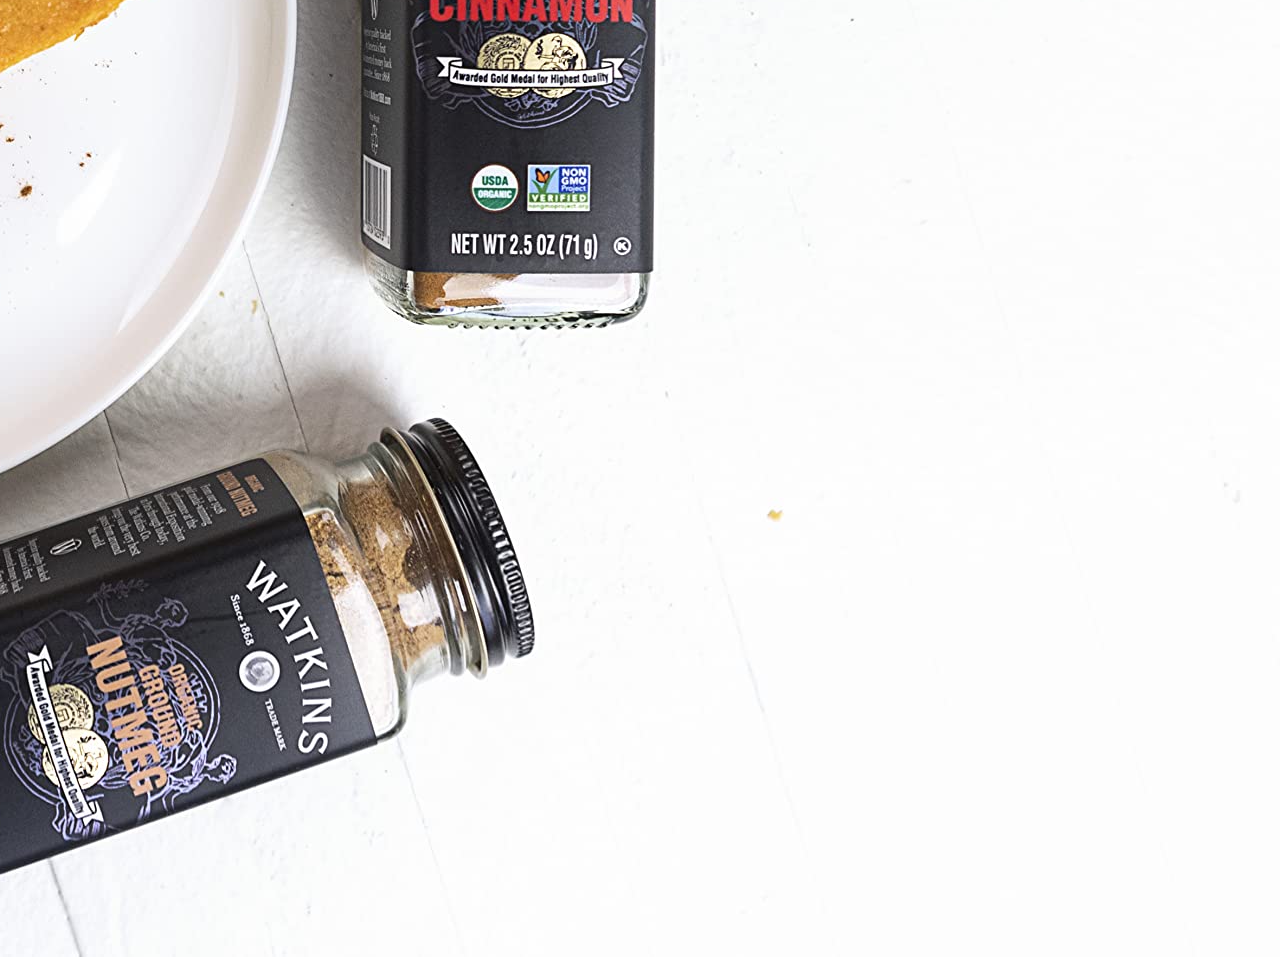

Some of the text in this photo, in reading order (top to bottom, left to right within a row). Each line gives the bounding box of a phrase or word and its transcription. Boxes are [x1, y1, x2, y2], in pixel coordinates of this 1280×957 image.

[452, 70, 609, 86] Awarded Gold Medal for Highest Quality
[481, 175, 508, 186] USDA
[561, 168, 587, 177] NON
[561, 176, 587, 185] GMO
[477, 189, 512, 199] ORGANIC
[531, 194, 587, 202] VERIFIED
[561, 185, 586, 193] Project
[451, 232, 598, 260] NET WT 2.5 OZ (71 g)
[228, 487, 258, 518] NUTMEG
[138, 530, 152, 541] Co.
[229, 593, 254, 646] Since 1868
[245, 559, 331, 753] WATKINS
[137, 663, 182, 748] GROUND
[167, 662, 204, 732] ORGANIC
[84, 635, 170, 796] NUTMEG
[263, 698, 287, 751] TRADE MARK
[28, 665, 85, 814] Awarded Gold Medal for Highest Quality
